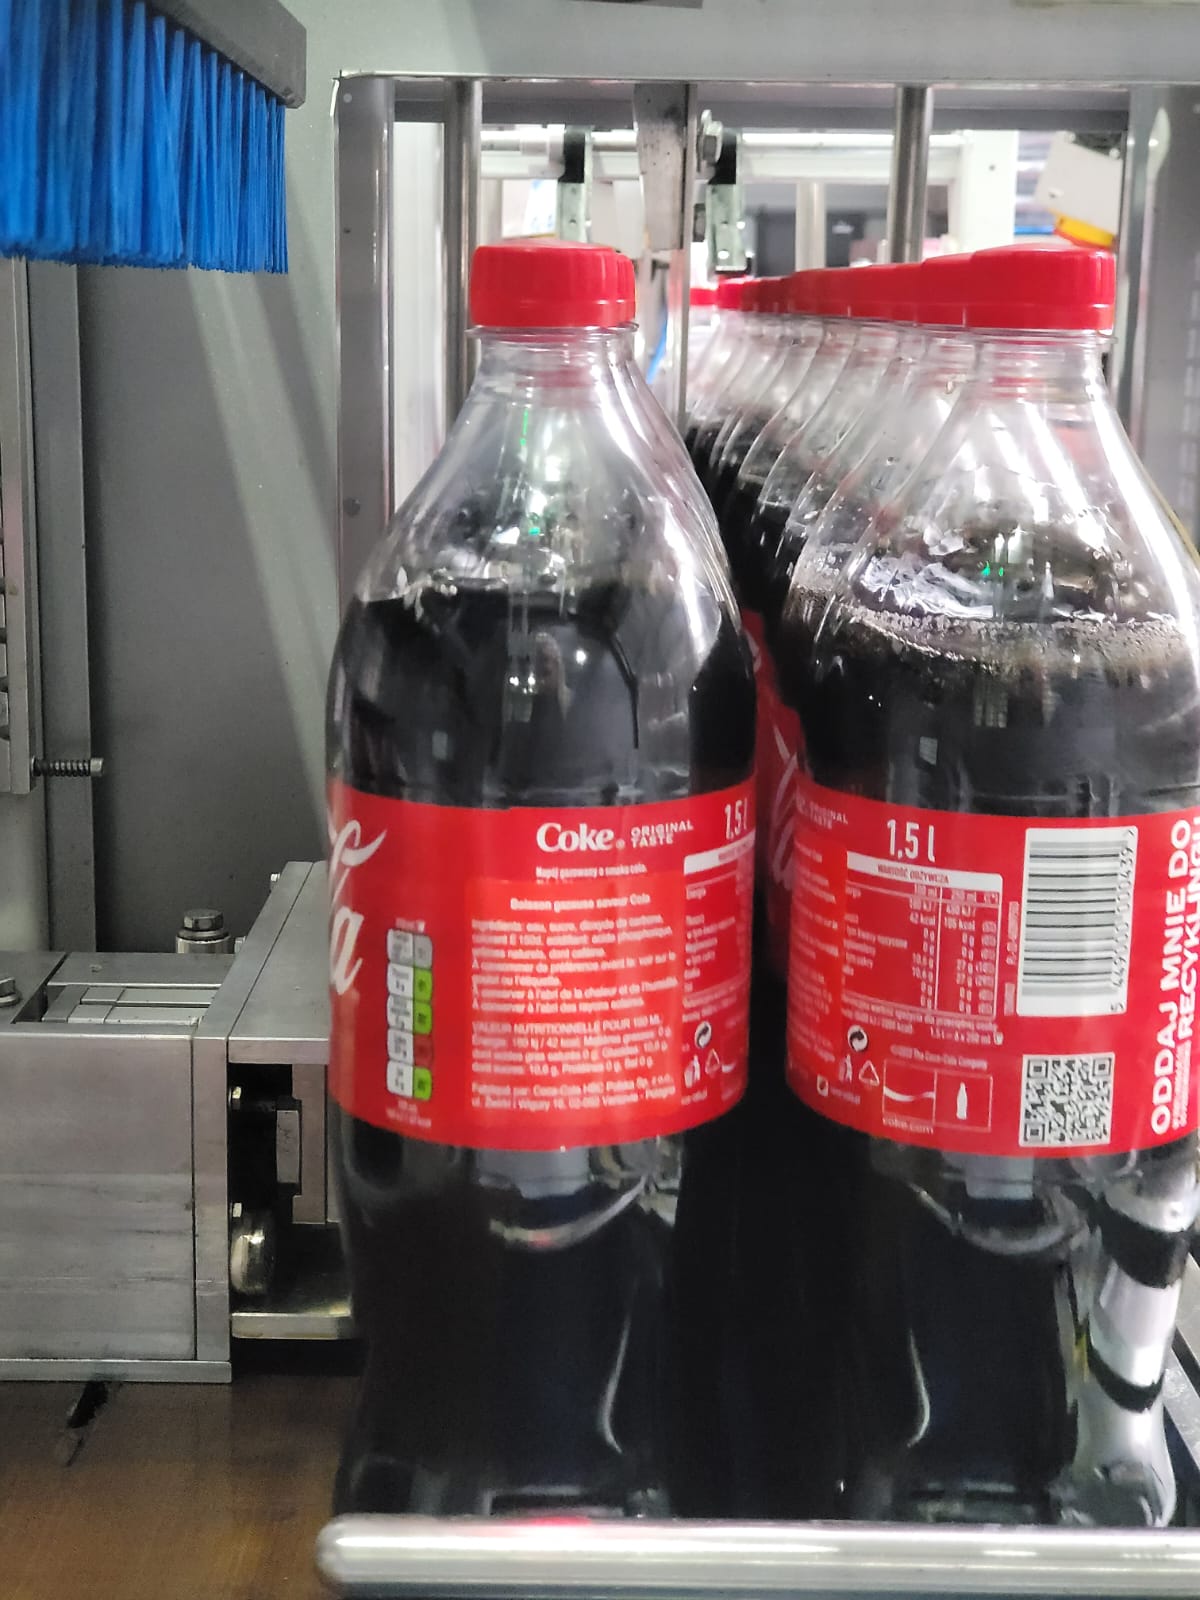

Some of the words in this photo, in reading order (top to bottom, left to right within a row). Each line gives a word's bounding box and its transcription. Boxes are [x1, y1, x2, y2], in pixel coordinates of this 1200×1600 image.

[536, 822, 614, 852] Coke
[631, 820, 693, 837] ORIGINAL
[631, 833, 674, 848] TASTE
[887, 819, 919, 859] 1,5
[1168, 819, 1191, 878] DO
[1160, 887, 1186, 991] MNIE
[1151, 1001, 1178, 1135] ODDAJ
